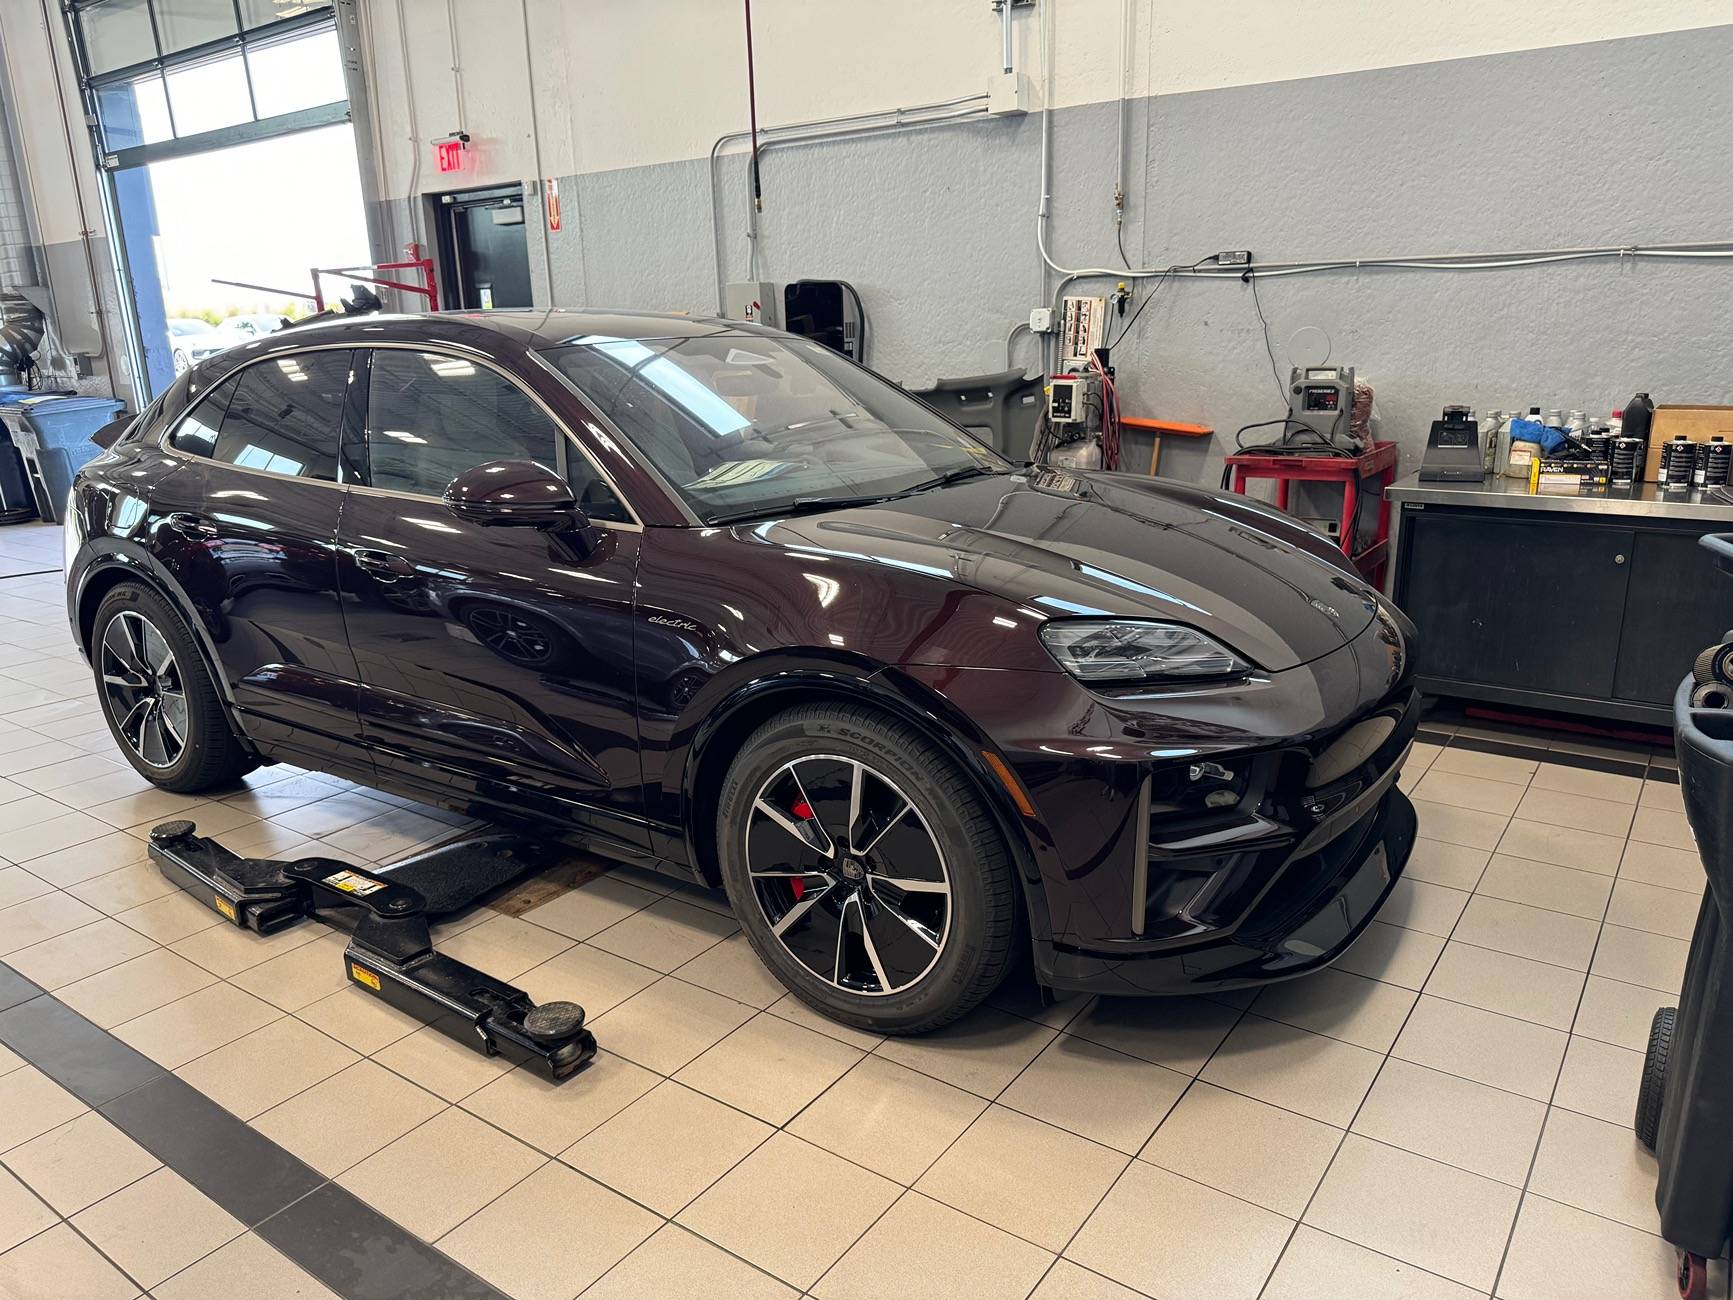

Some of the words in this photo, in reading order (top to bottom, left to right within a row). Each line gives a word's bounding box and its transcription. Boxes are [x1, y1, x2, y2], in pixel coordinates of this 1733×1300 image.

[438, 143, 461, 171] EXIT
[647, 615, 697, 631] electric
[838, 727, 925, 783] SCORPION
